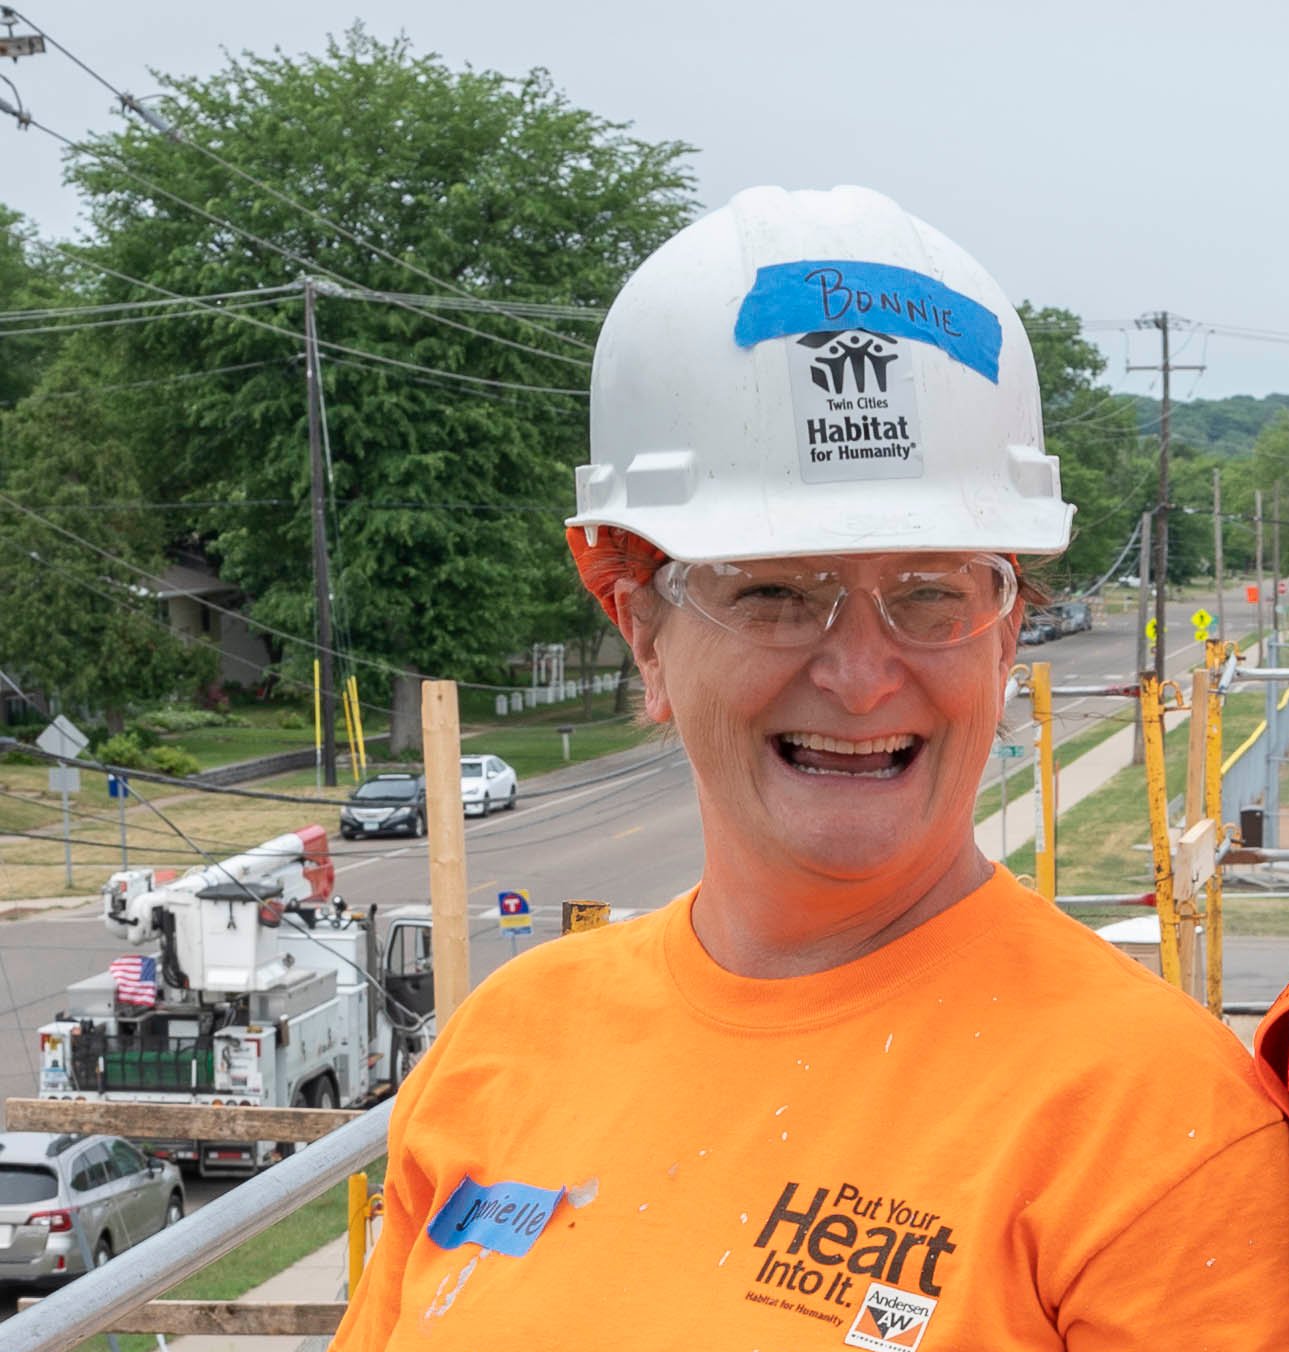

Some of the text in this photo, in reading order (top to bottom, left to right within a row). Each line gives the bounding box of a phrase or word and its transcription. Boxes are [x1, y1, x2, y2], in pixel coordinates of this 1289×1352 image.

[827, 396, 888, 411] Twin Cities
[807, 415, 909, 445] Habitat
[811, 448, 832, 463] for
[833, 1183, 940, 1231] Put Your
[753, 1182, 957, 1297] Heart
[755, 1250, 853, 1308] Into It.
[745, 1291, 844, 1327] Habitat for Humanity
[868, 1290, 929, 1317] Andersen
